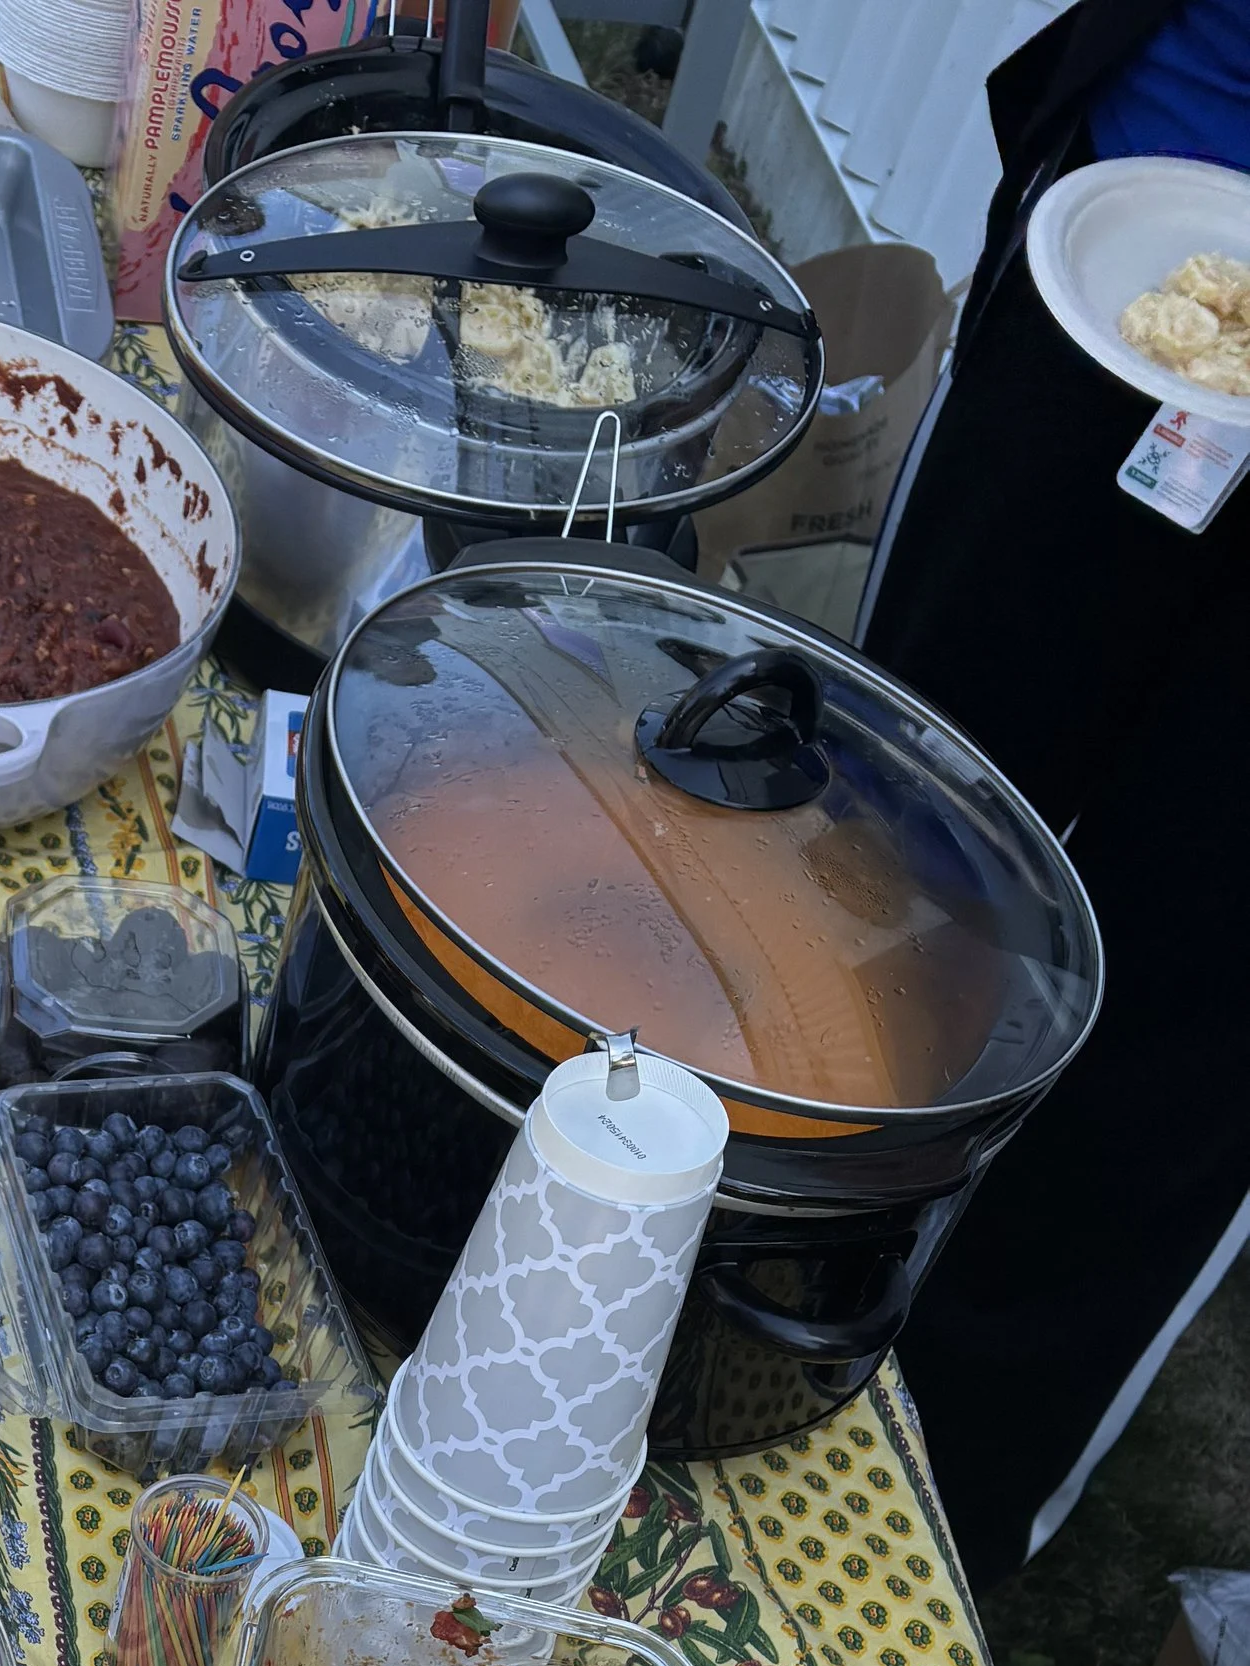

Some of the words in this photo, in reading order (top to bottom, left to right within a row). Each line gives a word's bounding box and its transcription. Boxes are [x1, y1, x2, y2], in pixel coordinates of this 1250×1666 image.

[144, 0, 181, 150] PAMPLEMOUSS
[171, 62, 193, 142] SPARKLING
[186, 7, 202, 56] WATER
[139, 153, 158, 222] NATURALLY
